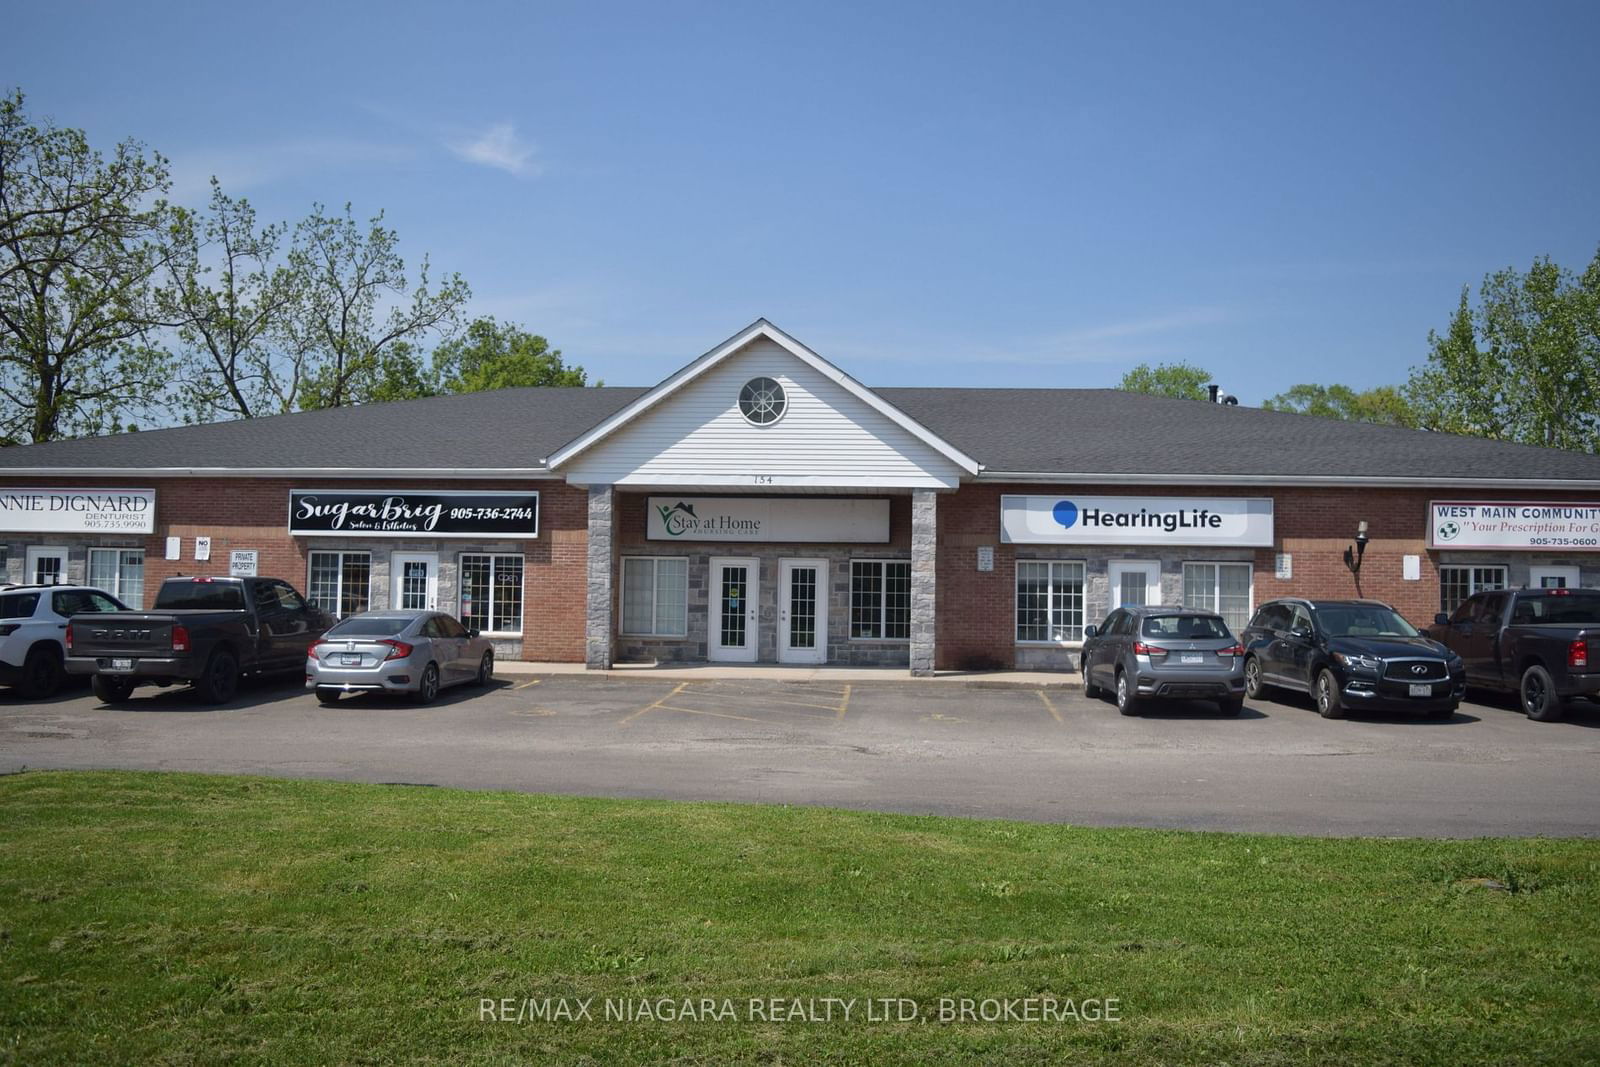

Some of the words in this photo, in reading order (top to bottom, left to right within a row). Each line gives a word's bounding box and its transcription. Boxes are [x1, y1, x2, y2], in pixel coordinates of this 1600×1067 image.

[754, 475, 773, 484] 154
[49, 495, 148, 512] DIGNARD
[85, 512, 146, 521] DENTURIST
[450, 507, 532, 520] 905-736-2744
[1437, 507, 1477, 518] WEST
[1481, 507, 1516, 519] MAIN
[1521, 507, 1600, 520] COMMUNIT
[84, 520, 147, 530] 905.735.9990
[672, 515, 700, 534] Stay
[703, 517, 715, 529] at
[719, 515, 761, 530] Home
[1082, 508, 1222, 532] HearingLife
[1500, 521, 1565, 535] Prescription
[1568, 522, 1588, 533] For
[1529, 538, 1597, 546] 905-735-0600
[235, 552, 254, 561] PRIVATE
[232, 562, 256, 570] PROPERTY
